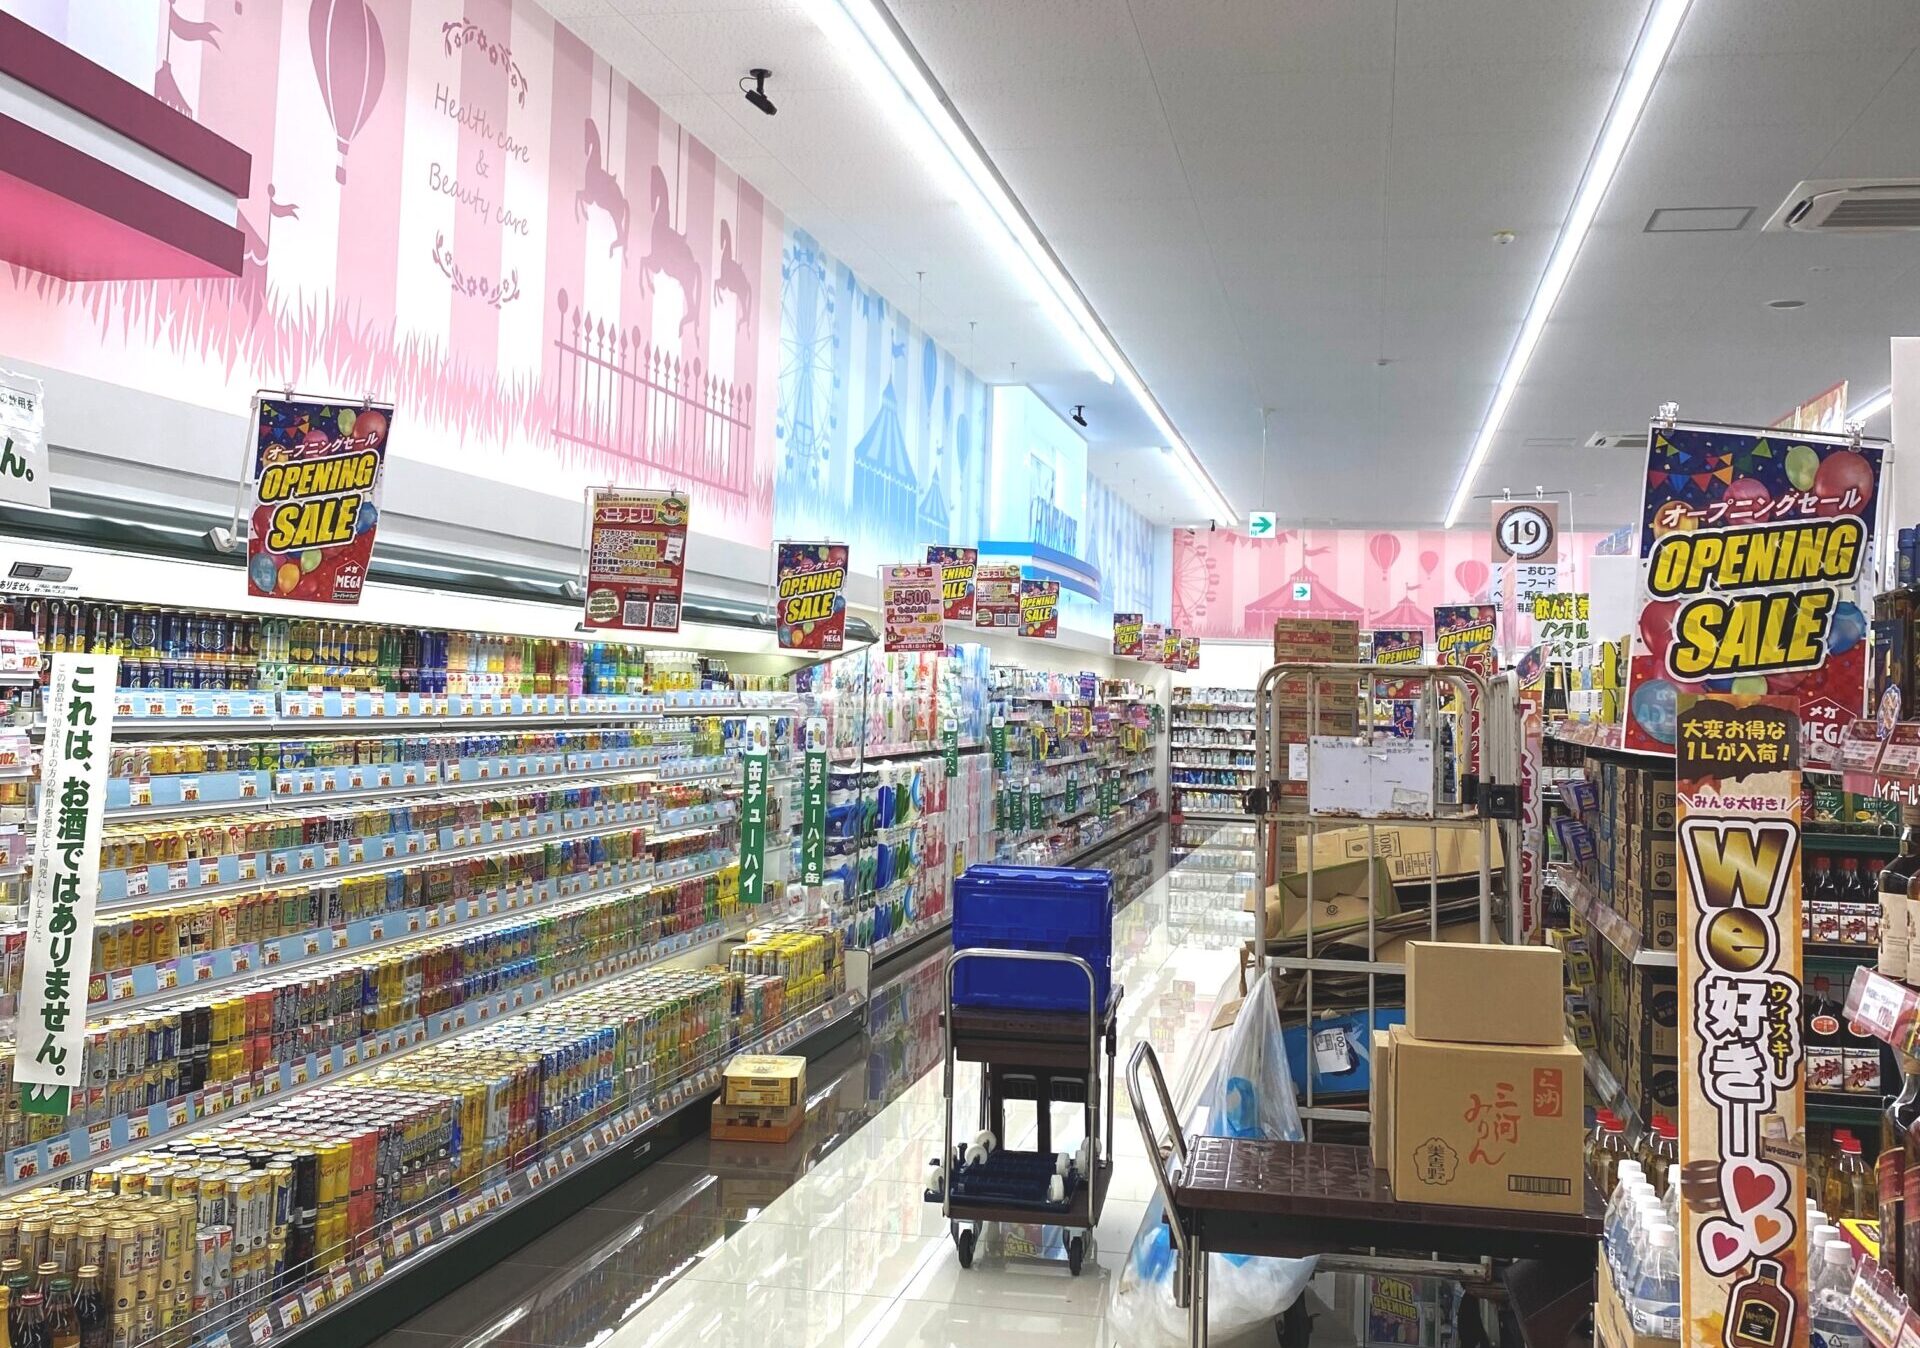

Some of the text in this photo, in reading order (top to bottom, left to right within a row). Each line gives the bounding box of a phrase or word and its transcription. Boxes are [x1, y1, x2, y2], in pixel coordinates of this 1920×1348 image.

[434, 82, 530, 163] Health care
[476, 149, 489, 178] &
[429, 162, 529, 236] Beauty care
[267, 432, 378, 461] オープニングセール
[259, 451, 378, 502] OPENING
[269, 495, 361, 550] SALE
[1661, 488, 1863, 528] オープニングセール
[1508, 519, 1541, 546] 19
[1649, 518, 1864, 596] OPENING
[335, 575, 361, 589] MEGA
[780, 568, 844, 599] OPENING
[785, 591, 837, 624] SALE
[1021, 594, 1057, 608] OPENING
[1023, 607, 1053, 623] SALE
[823, 634, 842, 643] MEGA
[1438, 624, 1494, 652] OPENING
[1670, 588, 1835, 678] SALE
[1375, 645, 1421, 666] OPENING
[1809, 706, 1840, 719] メガ
[1683, 719, 1786, 740] 大変お得な
[1694, 795, 1787, 812] みんな大好き!
[743, 760, 763, 894] 缶チューハイ
[804, 757, 823, 884] 缶チューハイ6缶
[34, 665, 97, 1078] これは、お酒ではありません。
[1689, 827, 1790, 973] We
[1769, 985, 1791, 1078] ウィスキー
[1493, 1082, 1521, 1144] 三河
[1463, 1093, 1506, 1166] みりん
[19, 1163, 35, 1179] 96
[53, 1151, 68, 1168] 96
